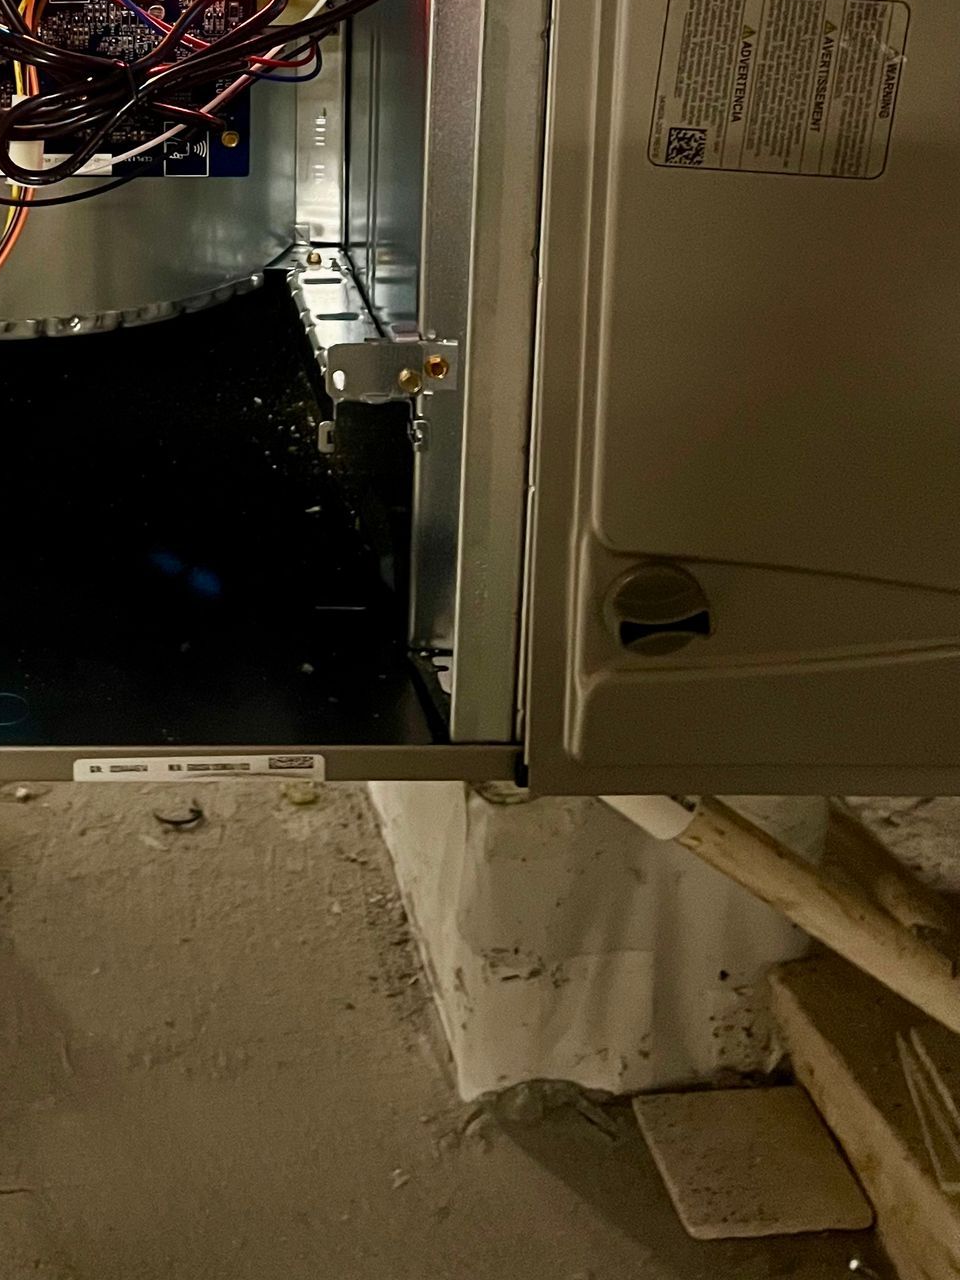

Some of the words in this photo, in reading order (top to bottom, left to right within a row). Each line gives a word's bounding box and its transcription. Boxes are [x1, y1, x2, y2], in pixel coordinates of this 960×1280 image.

[730, 40, 753, 123] ADVERTENCIA
[812, 35, 836, 133] AVERTISSEMENT
[878, 62, 897, 120] WARNING
